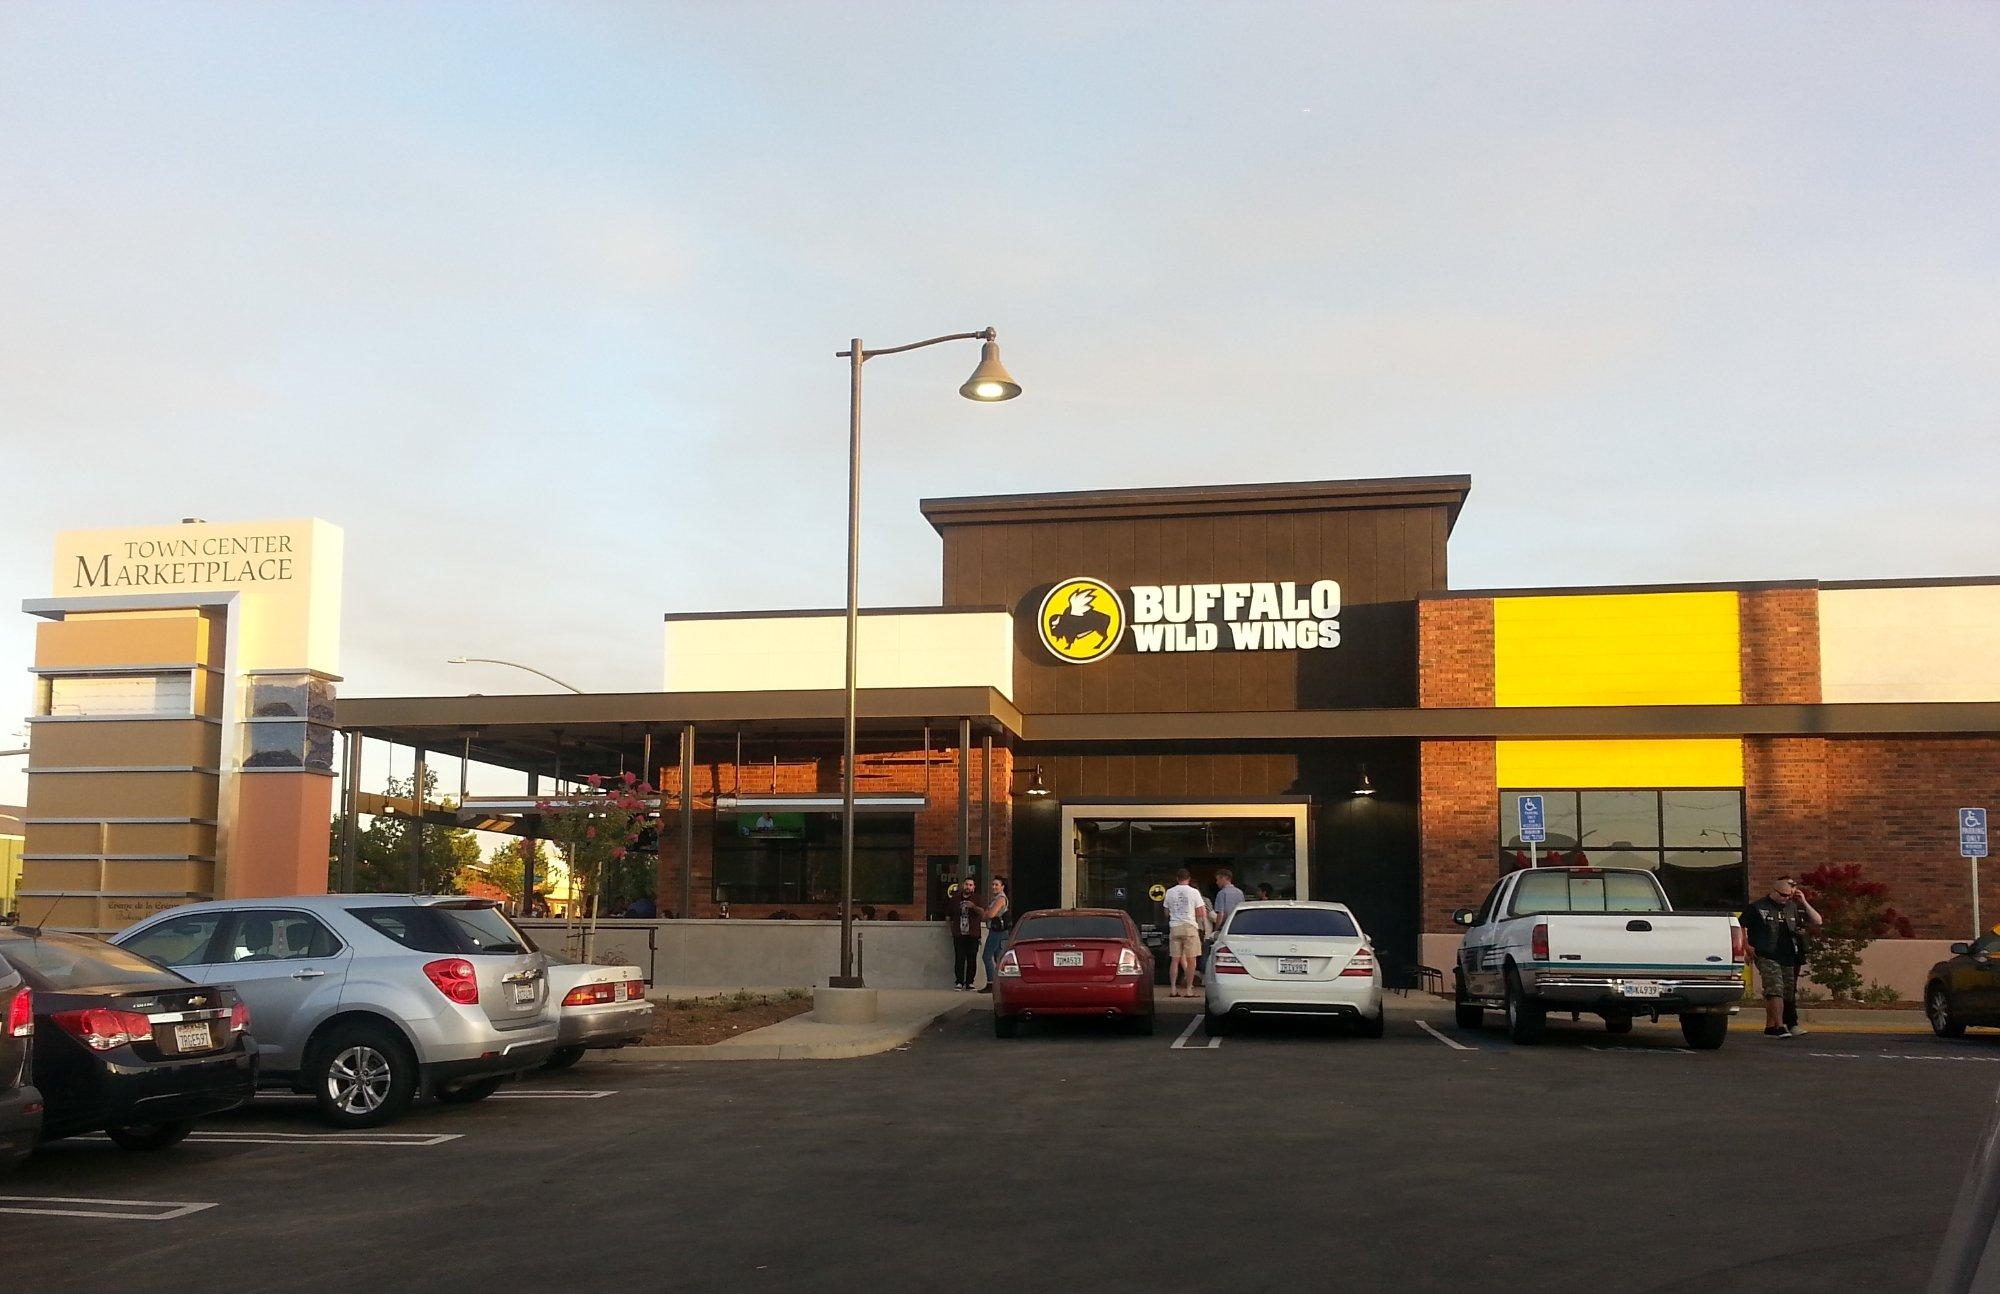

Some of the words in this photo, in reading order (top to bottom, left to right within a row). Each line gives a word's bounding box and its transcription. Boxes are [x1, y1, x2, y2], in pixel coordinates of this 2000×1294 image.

[124, 539, 198, 559] TOWN
[202, 535, 293, 556] CENTER
[72, 553, 293, 589] MARKETPLACE
[1130, 579, 1341, 623] BUFFALO
[1130, 622, 1218, 652] WILD
[1227, 619, 1341, 651] WINGS
